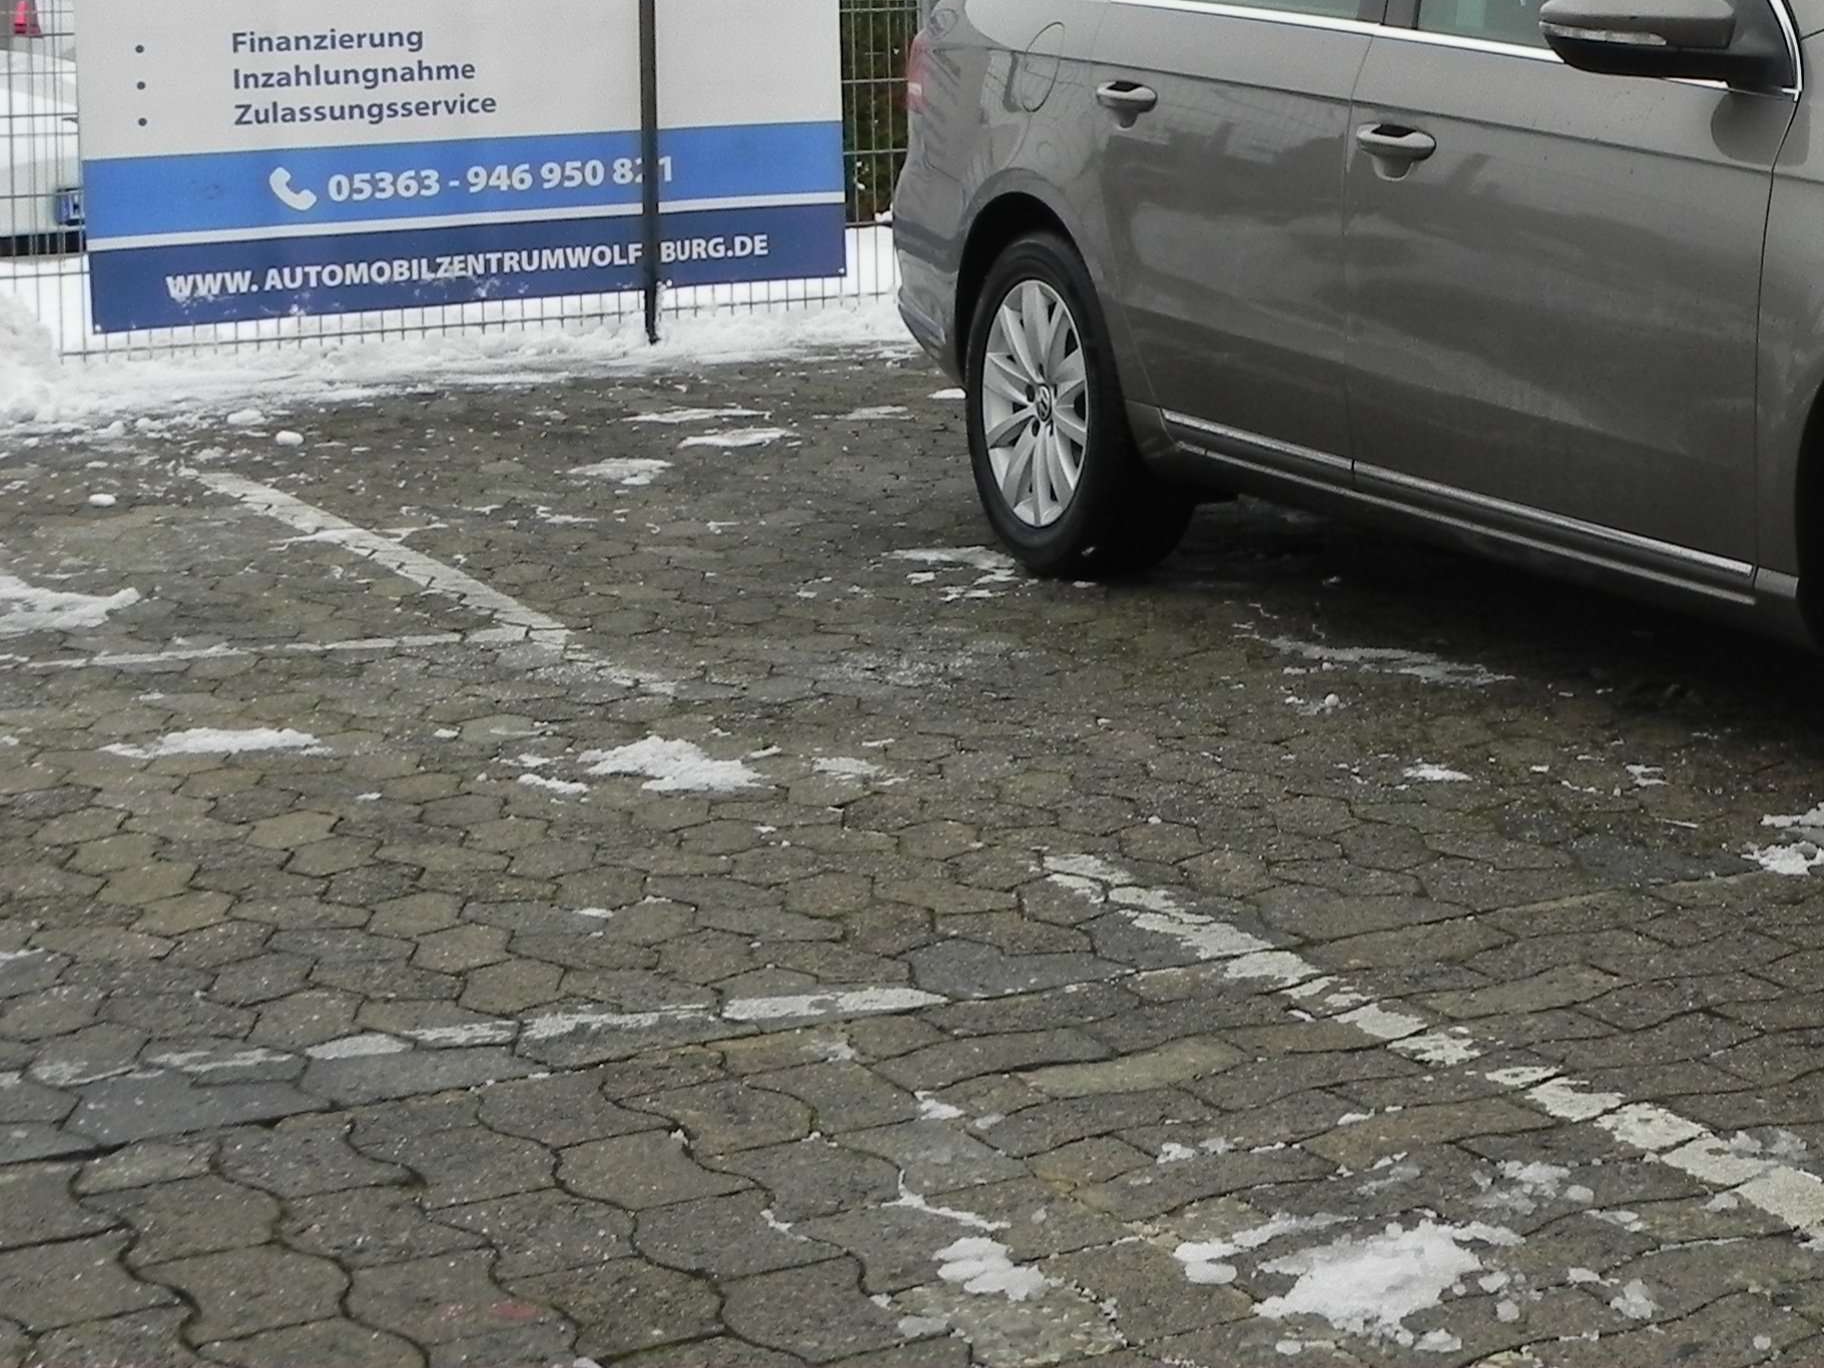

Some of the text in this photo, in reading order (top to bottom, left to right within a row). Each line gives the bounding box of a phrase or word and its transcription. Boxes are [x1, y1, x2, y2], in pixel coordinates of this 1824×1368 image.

[231, 28, 424, 53] Finanzierung
[232, 60, 477, 90] Inzahlungnahme
[234, 93, 498, 125] Zulassungsservice
[328, 168, 440, 202] 05363
[466, 163, 533, 193] 946
[540, 159, 605, 189] 950
[165, 234, 769, 300] WWW. AUTOMOBILZENTRUMWOLFBURG.DE
